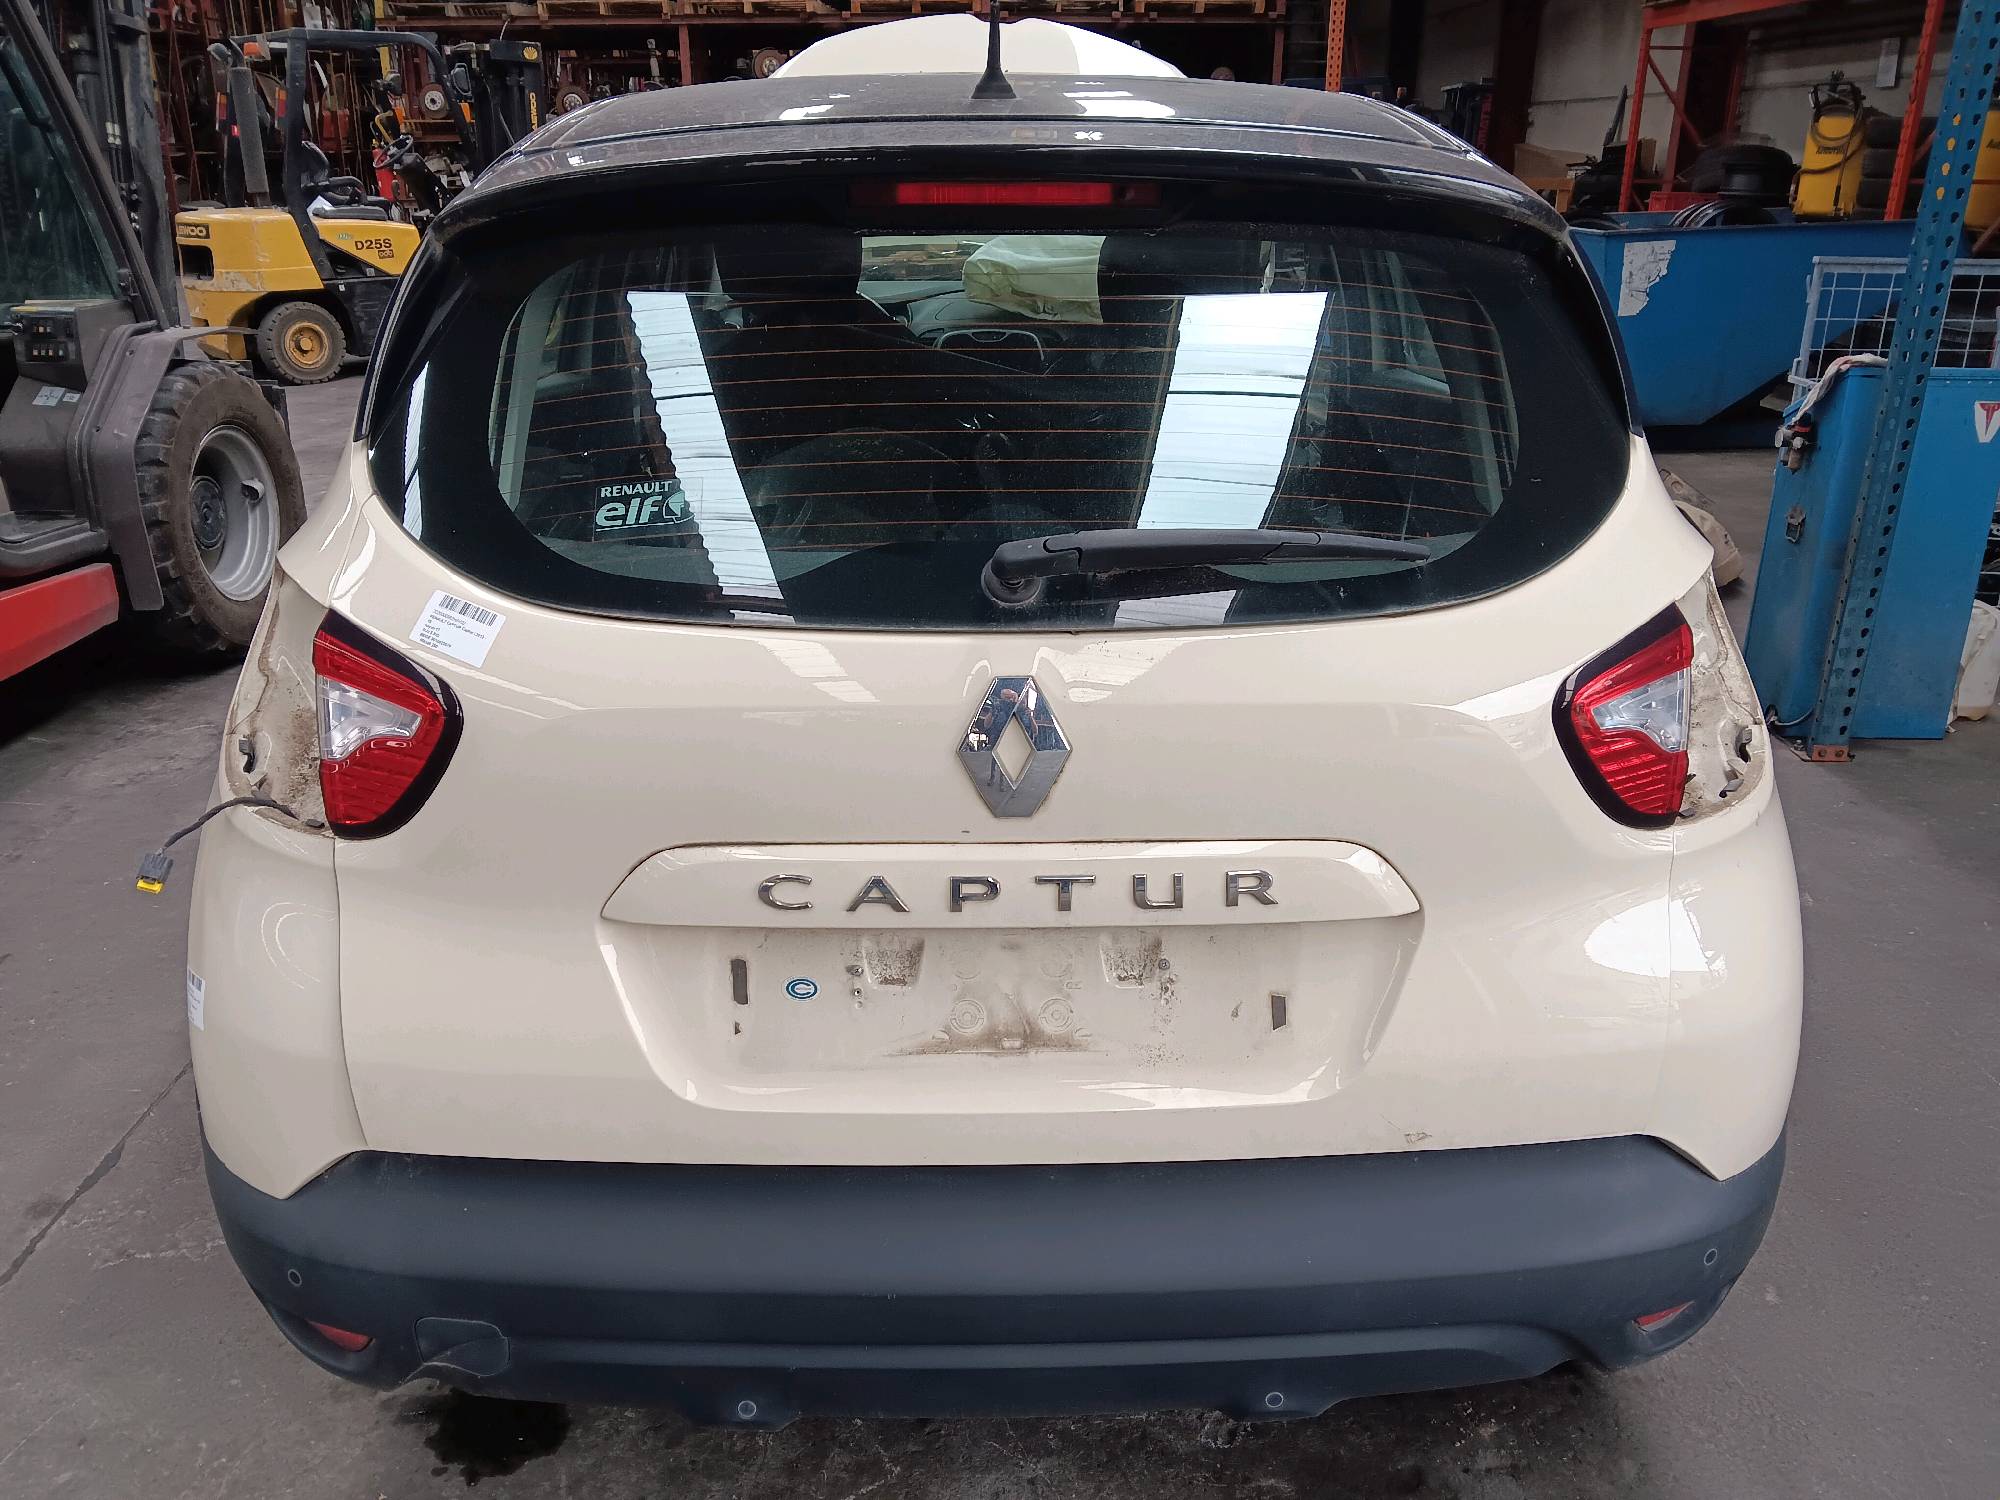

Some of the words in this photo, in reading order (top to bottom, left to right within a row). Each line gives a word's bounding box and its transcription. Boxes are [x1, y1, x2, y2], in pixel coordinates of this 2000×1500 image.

[355, 238, 392, 251] D25S
[600, 481, 672, 498] RENAULT
[595, 495, 663, 526] elf
[757, 869, 1280, 912] CAPTUR
